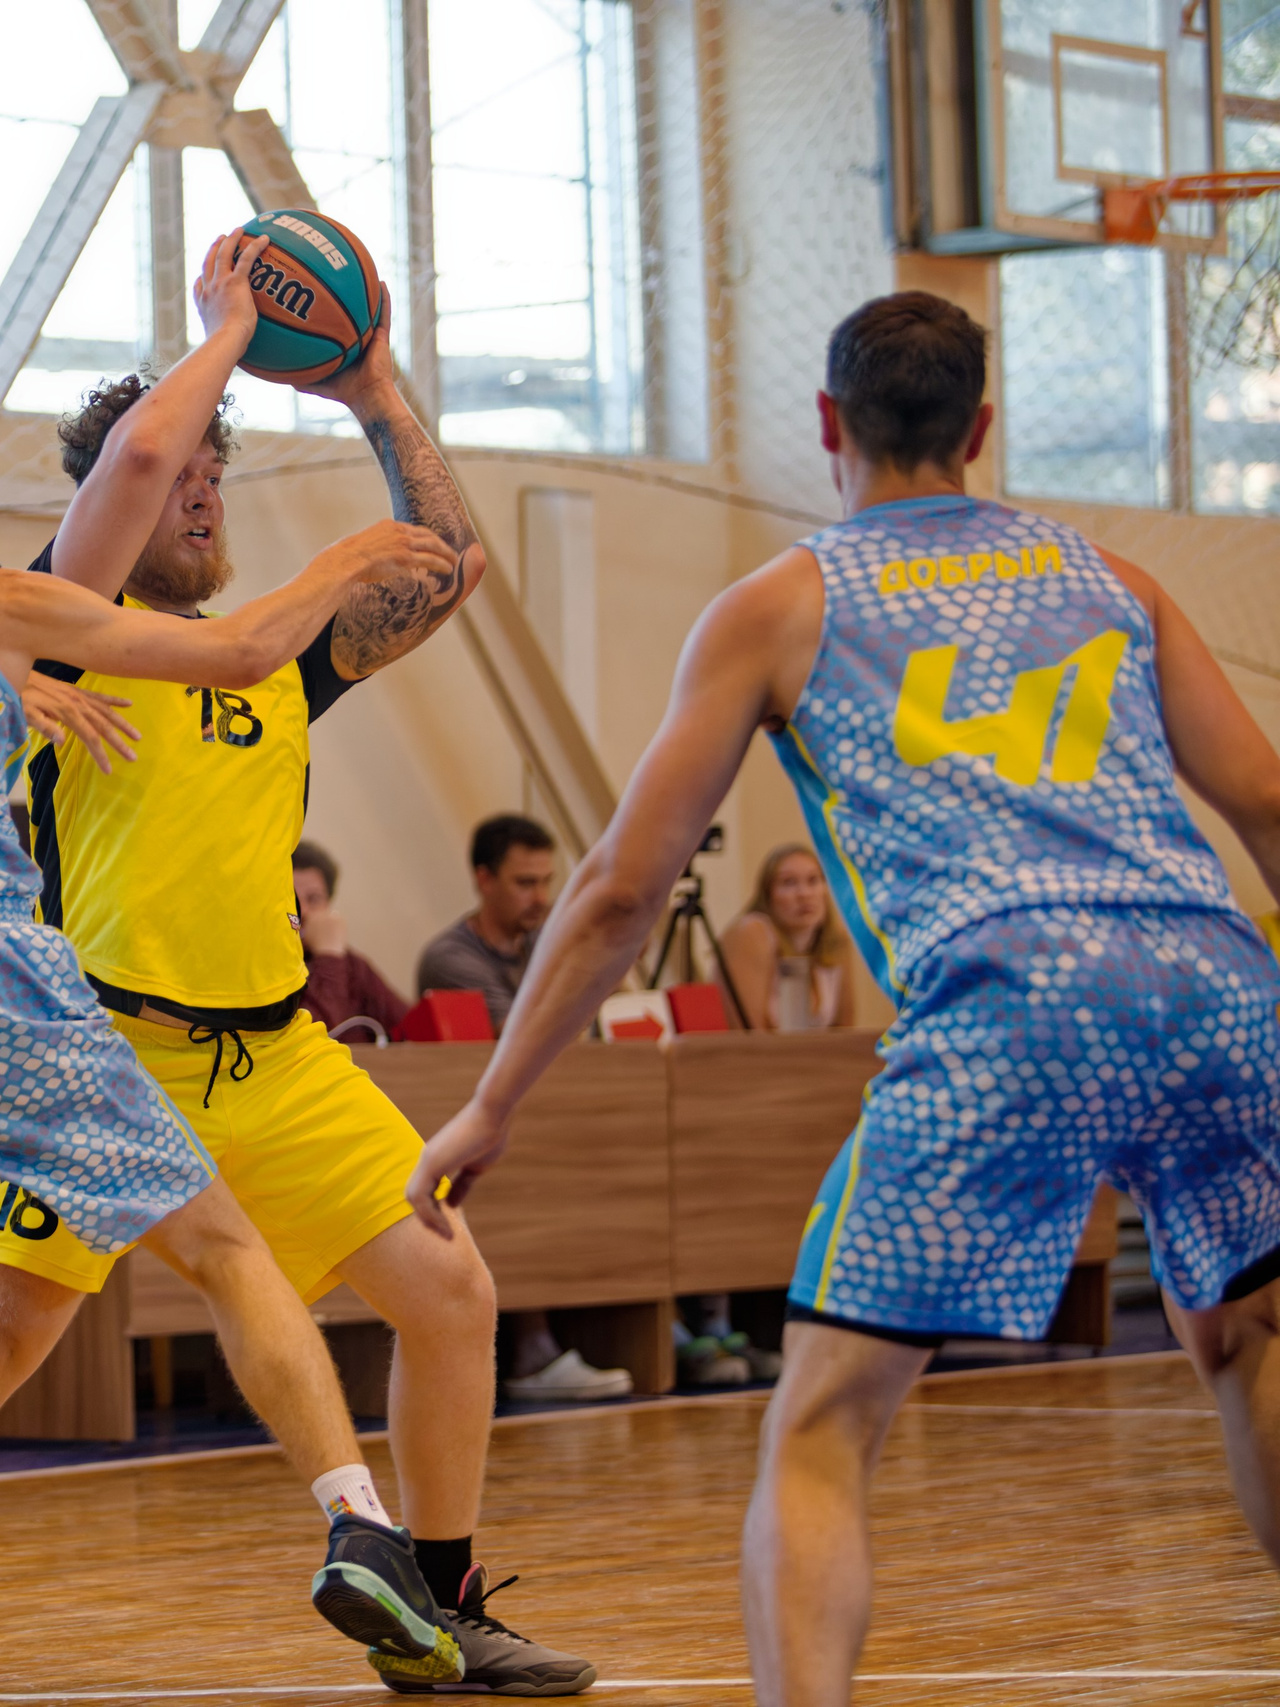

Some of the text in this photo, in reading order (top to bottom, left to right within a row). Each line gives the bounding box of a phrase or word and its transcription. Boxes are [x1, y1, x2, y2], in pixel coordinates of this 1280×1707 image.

[272, 213, 349, 272] SIBUR
[233, 246, 316, 323] Wils
[877, 540, 1063, 595] ДОБРЫЙ
[185, 685, 263, 749] 18
[893, 629, 1130, 786] 41
